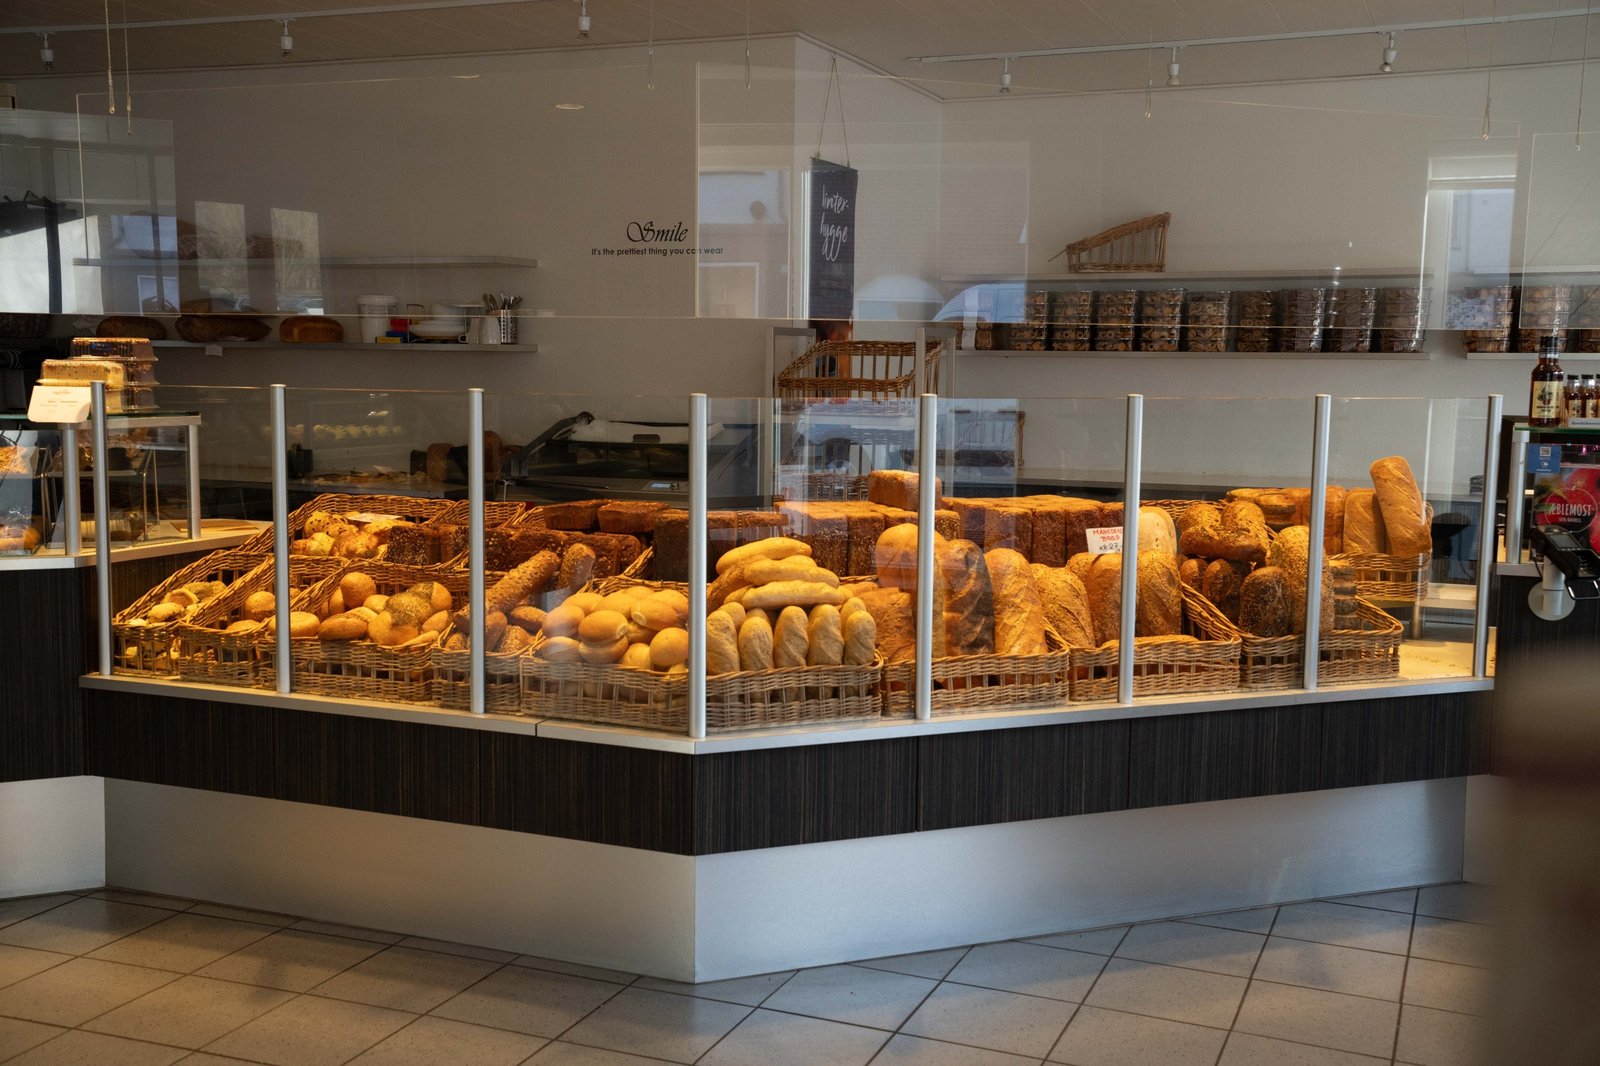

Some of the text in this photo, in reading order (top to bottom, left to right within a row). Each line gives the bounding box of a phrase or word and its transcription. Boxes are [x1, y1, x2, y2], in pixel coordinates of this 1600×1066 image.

[626, 221, 688, 243] Smile
[820, 211, 848, 262] hygge
[591, 248, 601, 256] It's
[603, 248, 615, 256] the
[617, 247, 647, 257] prettiest
[648, 247, 667, 257] thing
[669, 248, 684, 257] you
